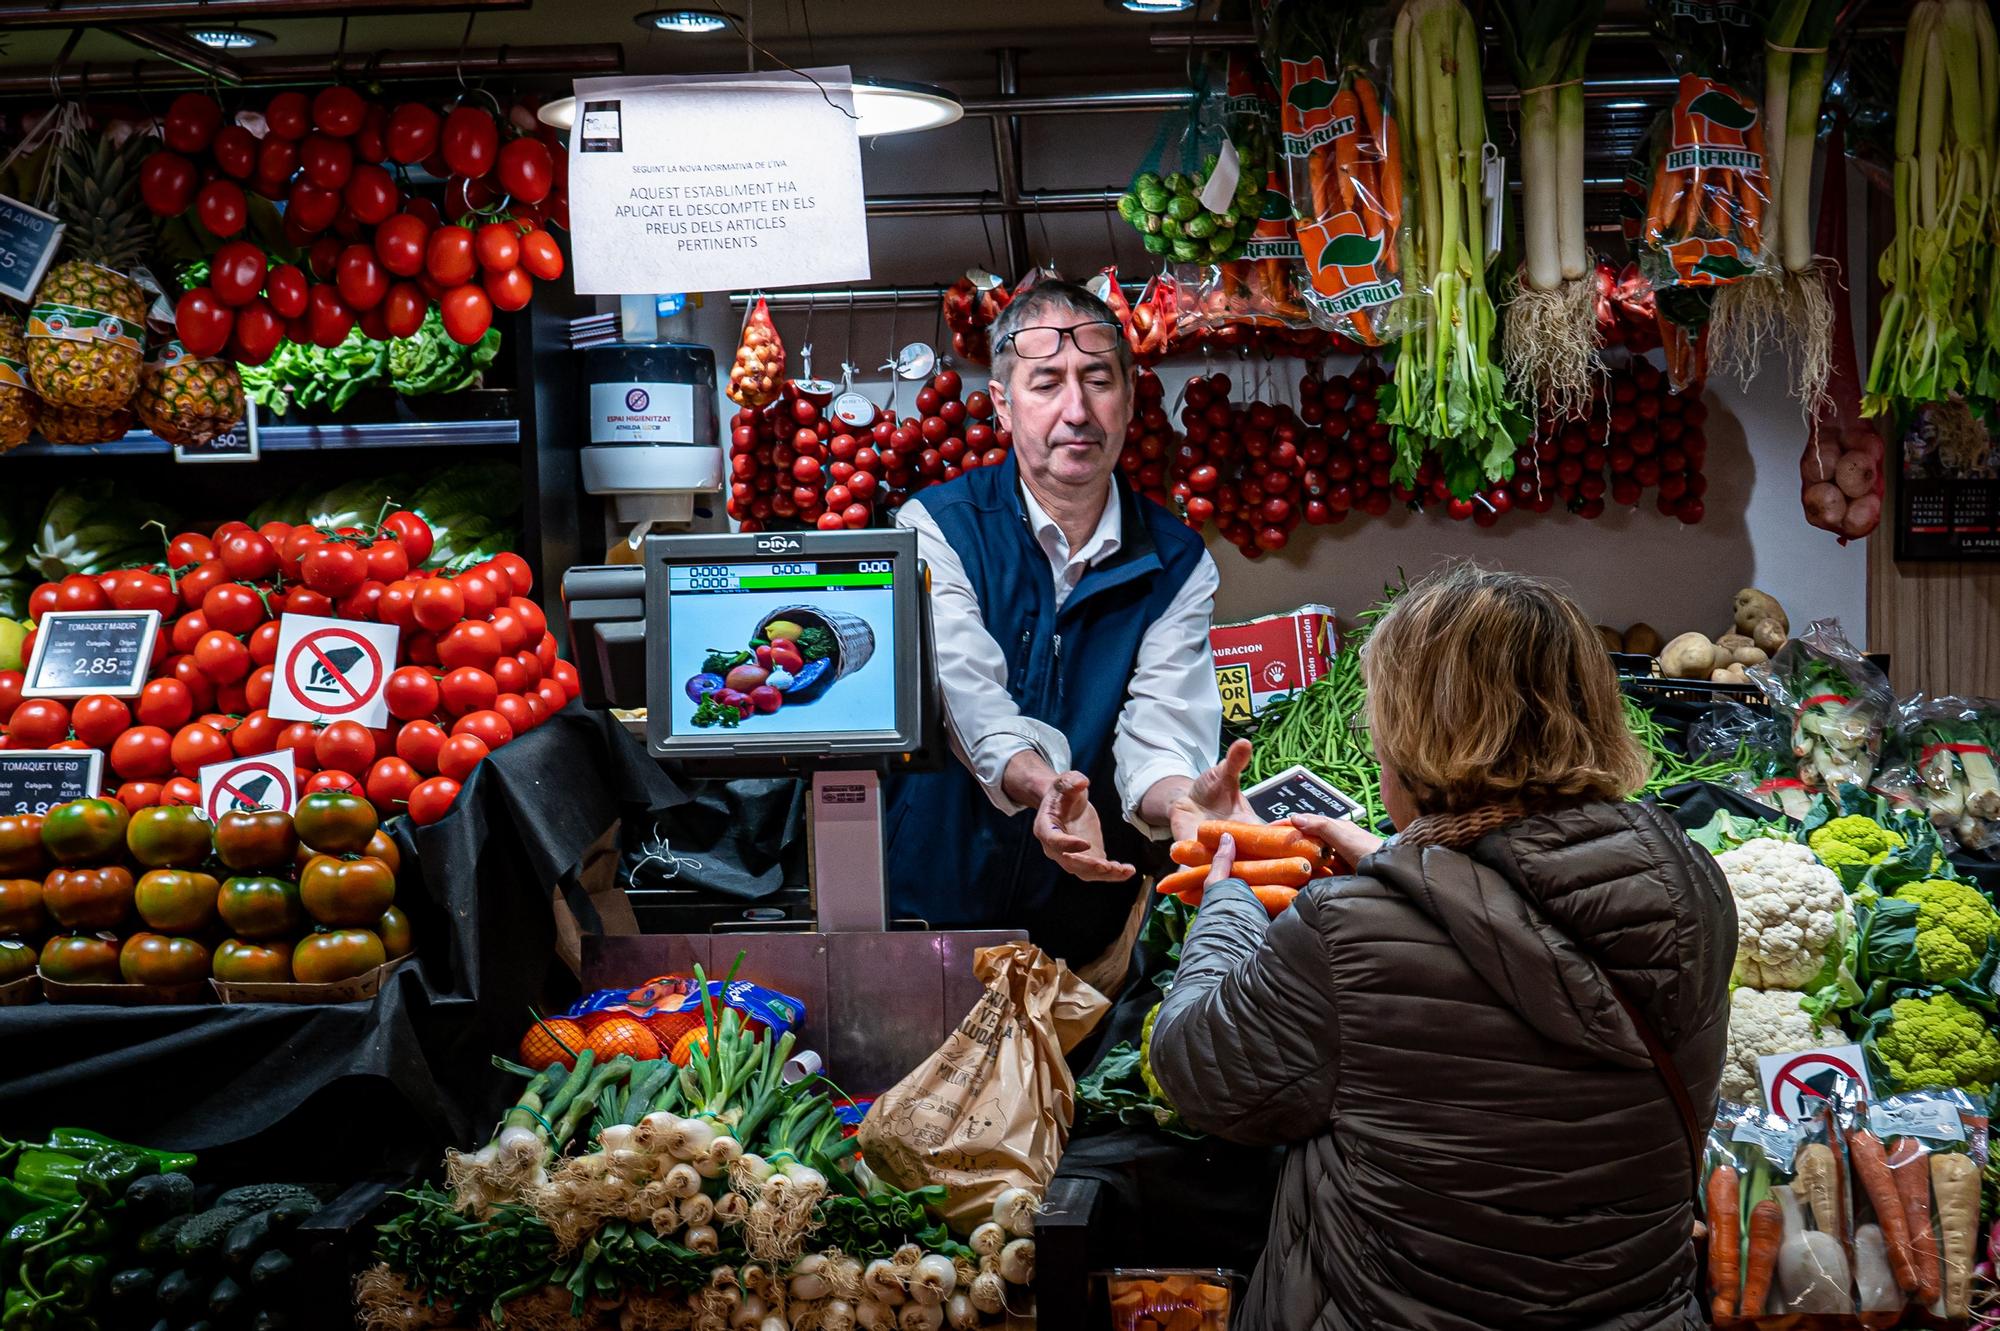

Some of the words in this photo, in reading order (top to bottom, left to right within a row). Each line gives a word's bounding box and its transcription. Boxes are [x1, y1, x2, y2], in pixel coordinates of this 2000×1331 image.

[1286, 118, 1354, 155] ERFRUIT
[632, 165, 666, 174] SEGUINT
[667, 165, 677, 173] LA
[679, 164, 702, 173] NOVA
[704, 162, 752, 172] NORMATIVA
[754, 161, 765, 170] DE
[1669, 151, 1761, 170] HERFRUIT
[629, 186, 681, 200] AQUEST
[684, 182, 774, 199] ESTABLIMENT
[777, 180, 797, 193] HA
[615, 204, 664, 218] APLICAT
[669, 204, 683, 217] EL
[687, 199, 768, 216] DESCOMPTE
[772, 198, 789, 211] EN
[794, 197, 816, 210] ELS
[646, 221, 688, 236] PREUS
[691, 220, 723, 234] DELS
[726, 217, 787, 232] ARTICLES
[677, 236, 758, 252] PERTINENTS
[1319, 281, 1401, 315] HERFRUIT
[758, 540, 800, 549] DINA
[859, 561, 890, 573] 0,00
[73, 657, 118, 677] 2,85
[1221, 687, 1245, 701] OR
[1222, 703, 1250, 719] A
[3, 762, 52, 772] TOMAQUET
[53, 762, 79, 771] VERD
